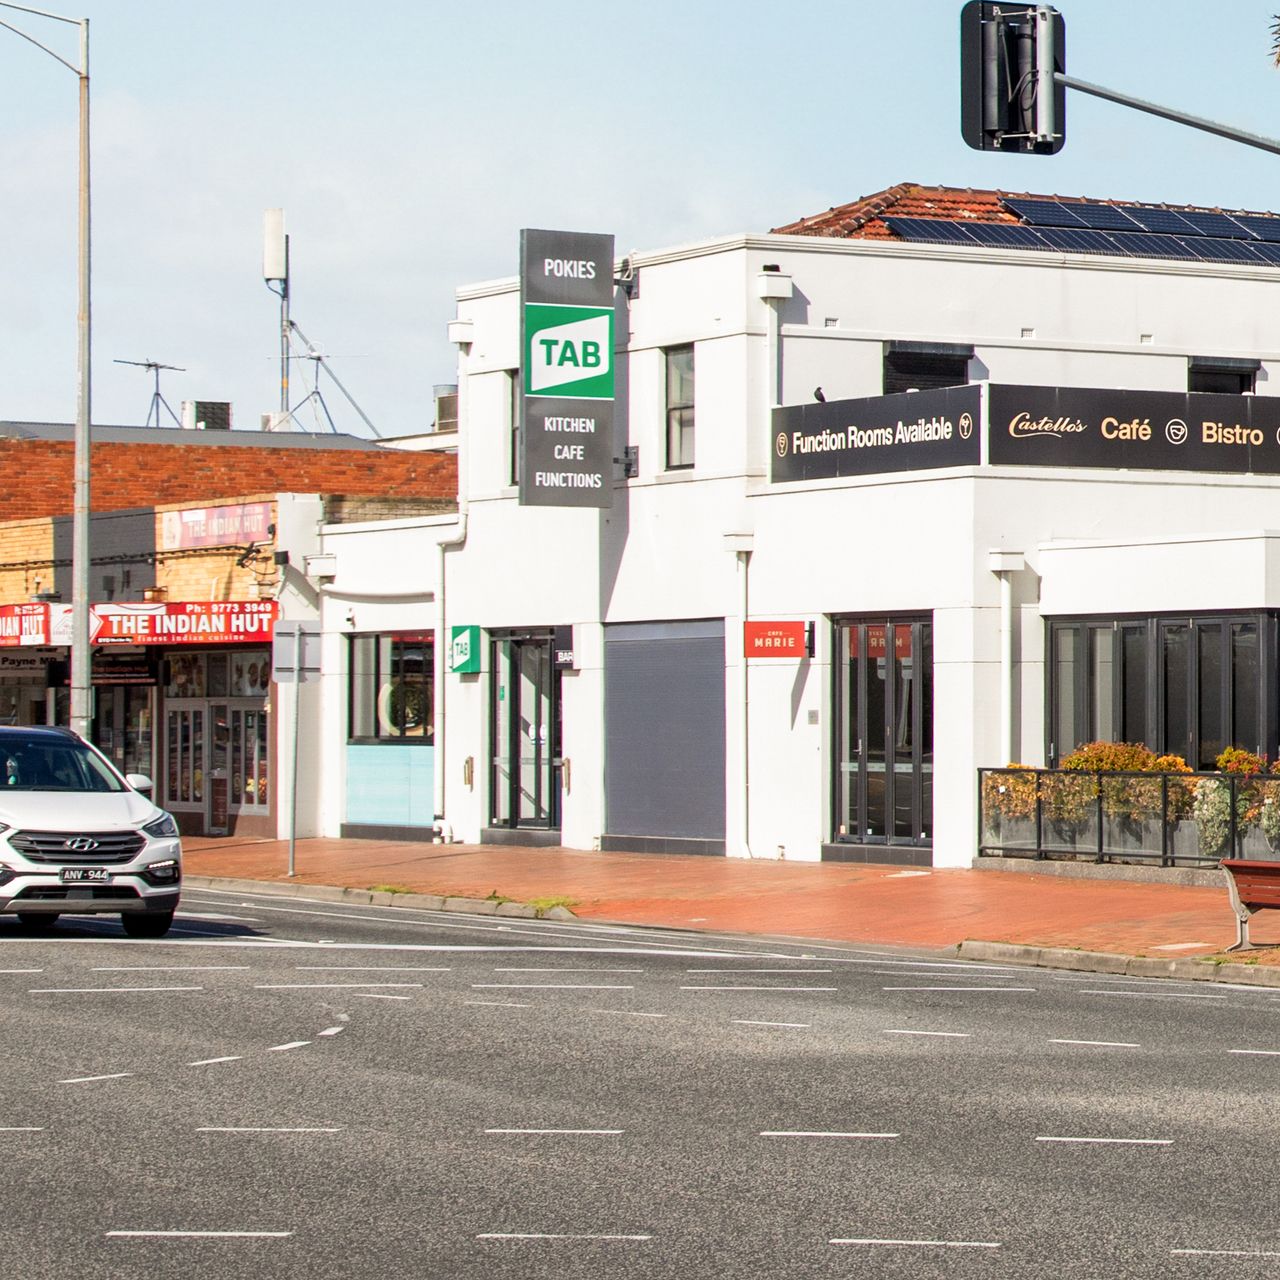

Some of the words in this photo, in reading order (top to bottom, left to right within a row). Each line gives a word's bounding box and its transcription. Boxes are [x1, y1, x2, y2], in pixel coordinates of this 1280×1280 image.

[544, 258, 595, 279] POKIES
[539, 339, 600, 368] TAB
[544, 417, 595, 433] KITCHEN
[793, 427, 846, 455] Function
[848, 425, 892, 448] Rooms
[895, 416, 952, 444] Available
[1009, 412, 1087, 438] Castello's
[1101, 417, 1152, 441] Café
[1202, 421, 1264, 446] Bistro
[554, 444, 584, 460] CAFE
[535, 472, 601, 488] FUNCTIONS
[188, 521, 207, 538] THE
[244, 514, 264, 533] HUT
[186, 604, 206, 613] Ph:
[212, 603, 239, 613] 9773
[245, 603, 272, 613] 3949
[0, 617, 19, 636] IAN
[22, 615, 44, 635] HUT
[109, 615, 149, 634] THE
[155, 614, 226, 634] INDIAN
[231, 613, 272, 633] HUT
[455, 642, 468, 656] TAB
[754, 637, 795, 648] MARIE
[2, 657, 36, 666] Payne
[558, 651, 573, 662] BAR
